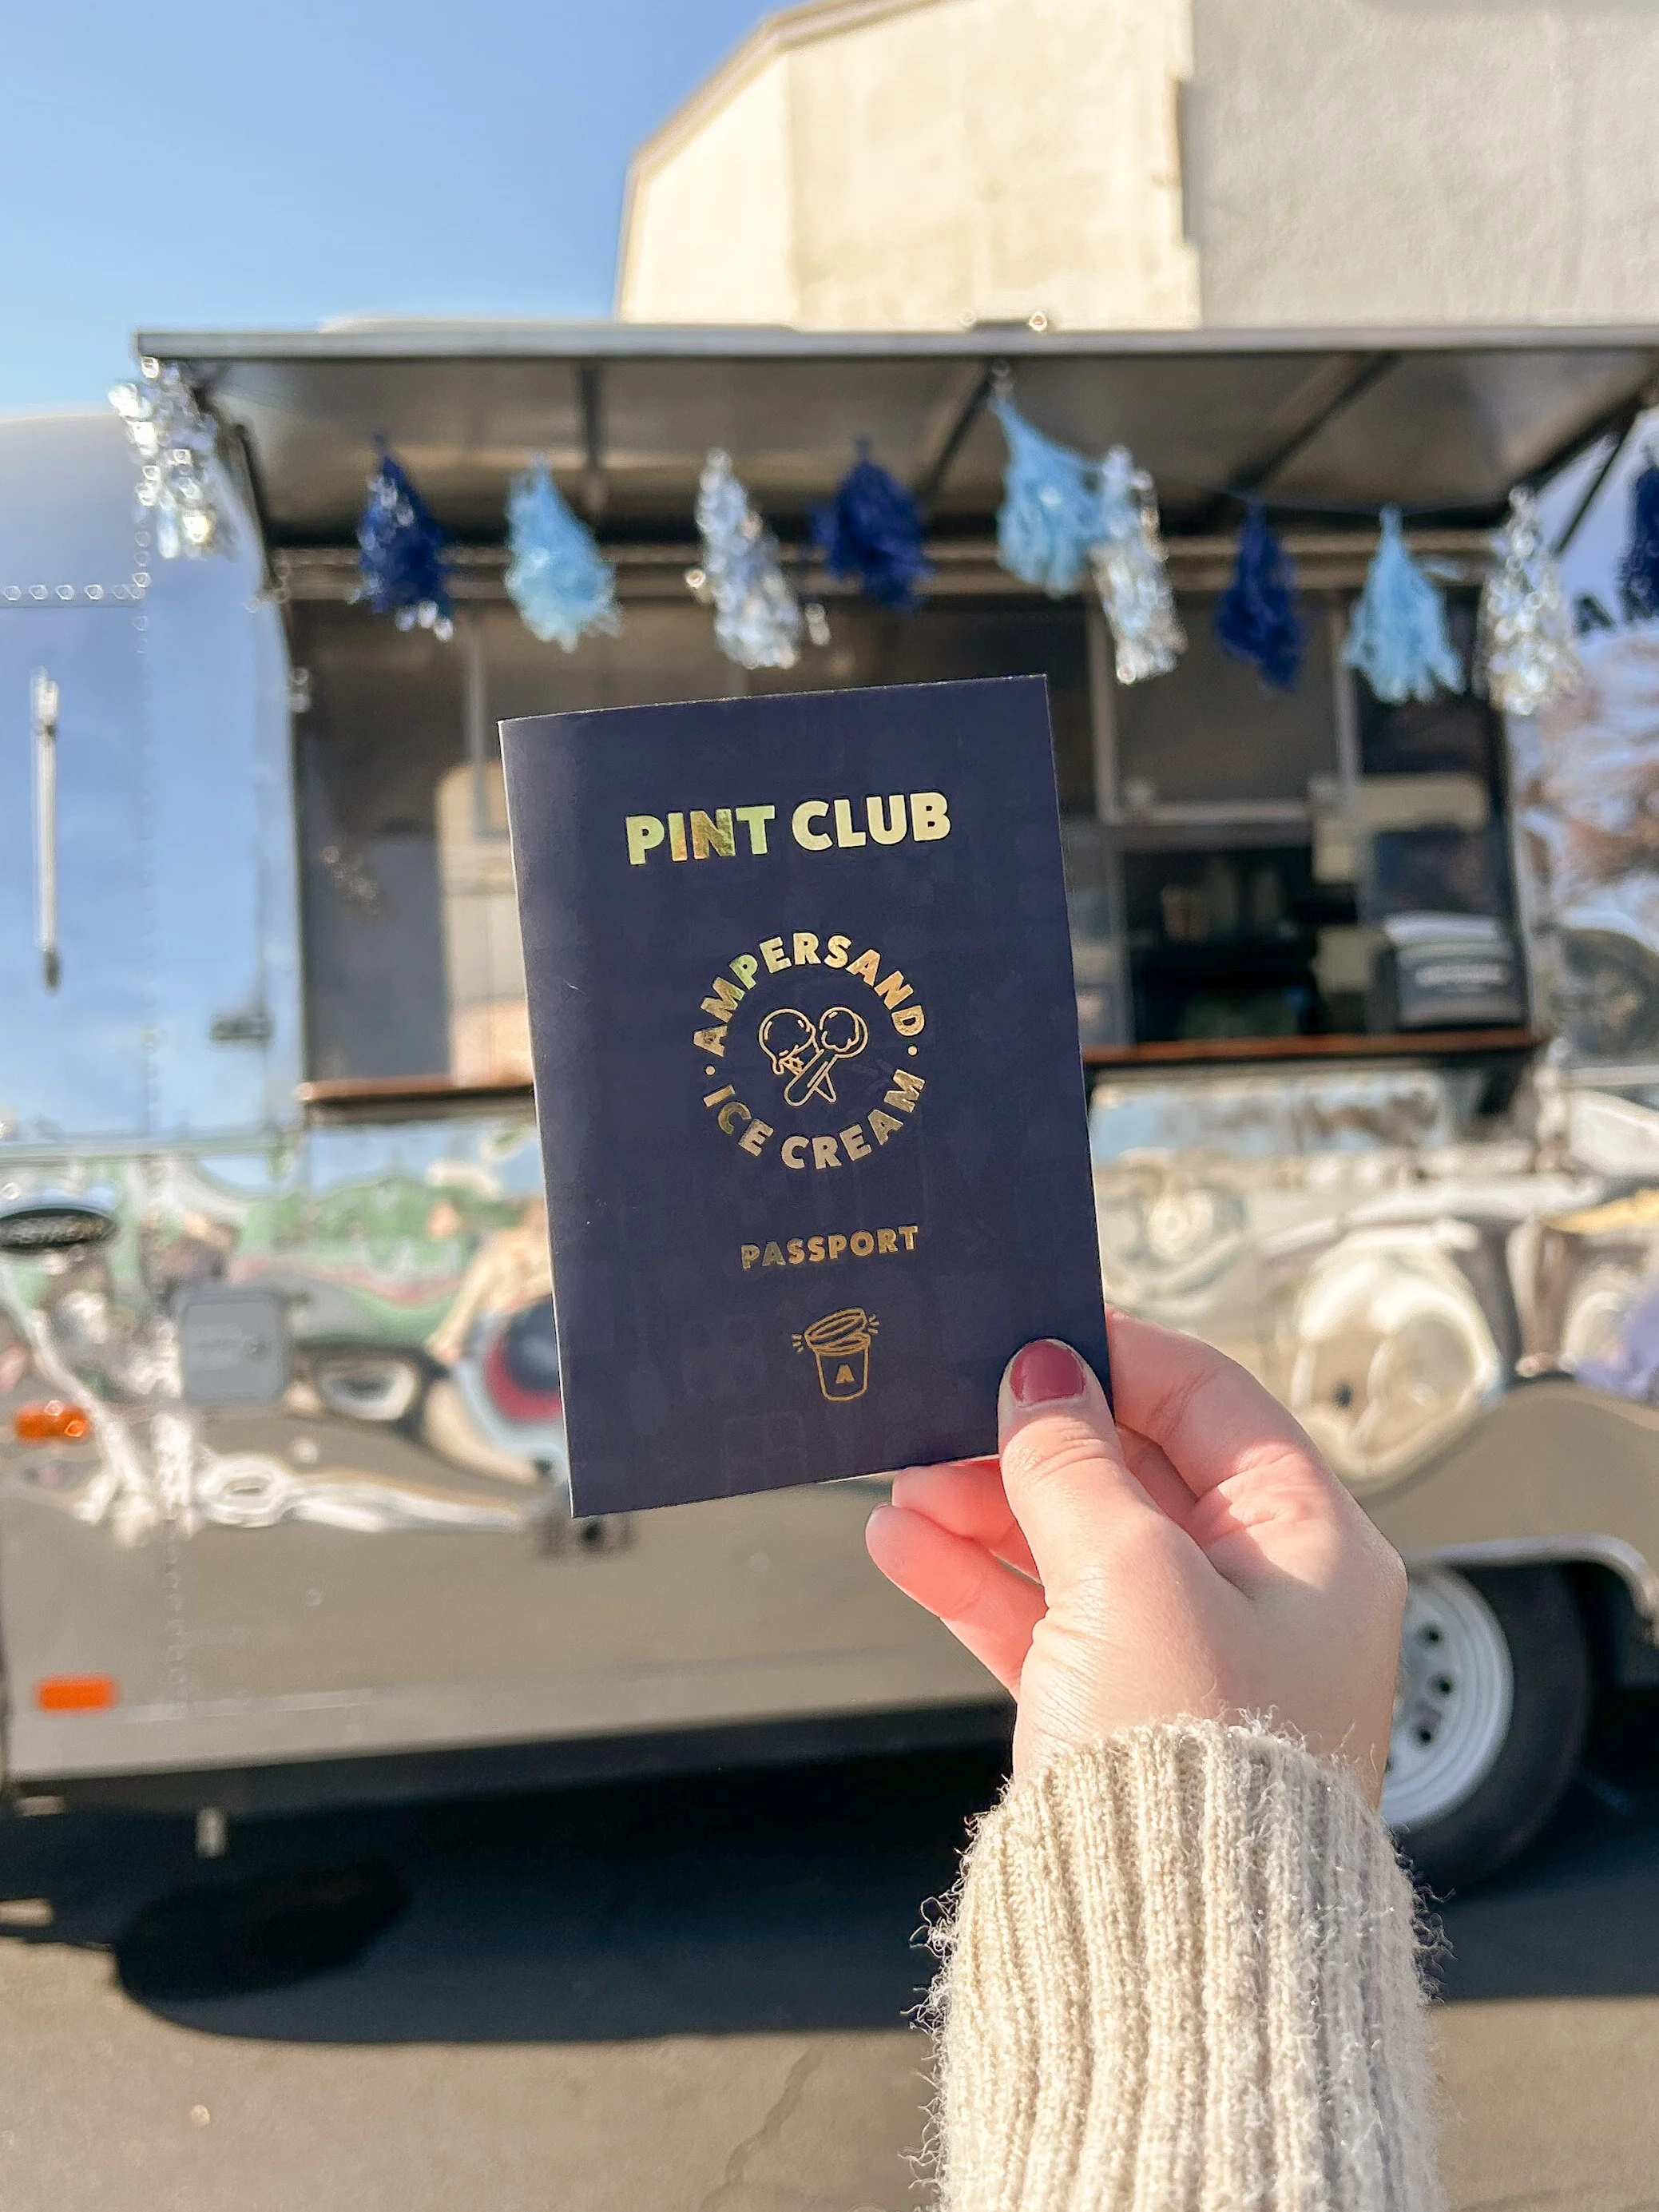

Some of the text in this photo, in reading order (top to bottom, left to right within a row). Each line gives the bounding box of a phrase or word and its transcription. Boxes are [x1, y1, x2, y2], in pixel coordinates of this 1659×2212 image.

[625, 792, 951, 865] PINT CLUB
[693, 931, 926, 1057] AMPERSAND
[703, 1069, 926, 1170] ICE CREAM
[740, 1225, 918, 1269] PASSPORT
[835, 1364, 855, 1384] A
